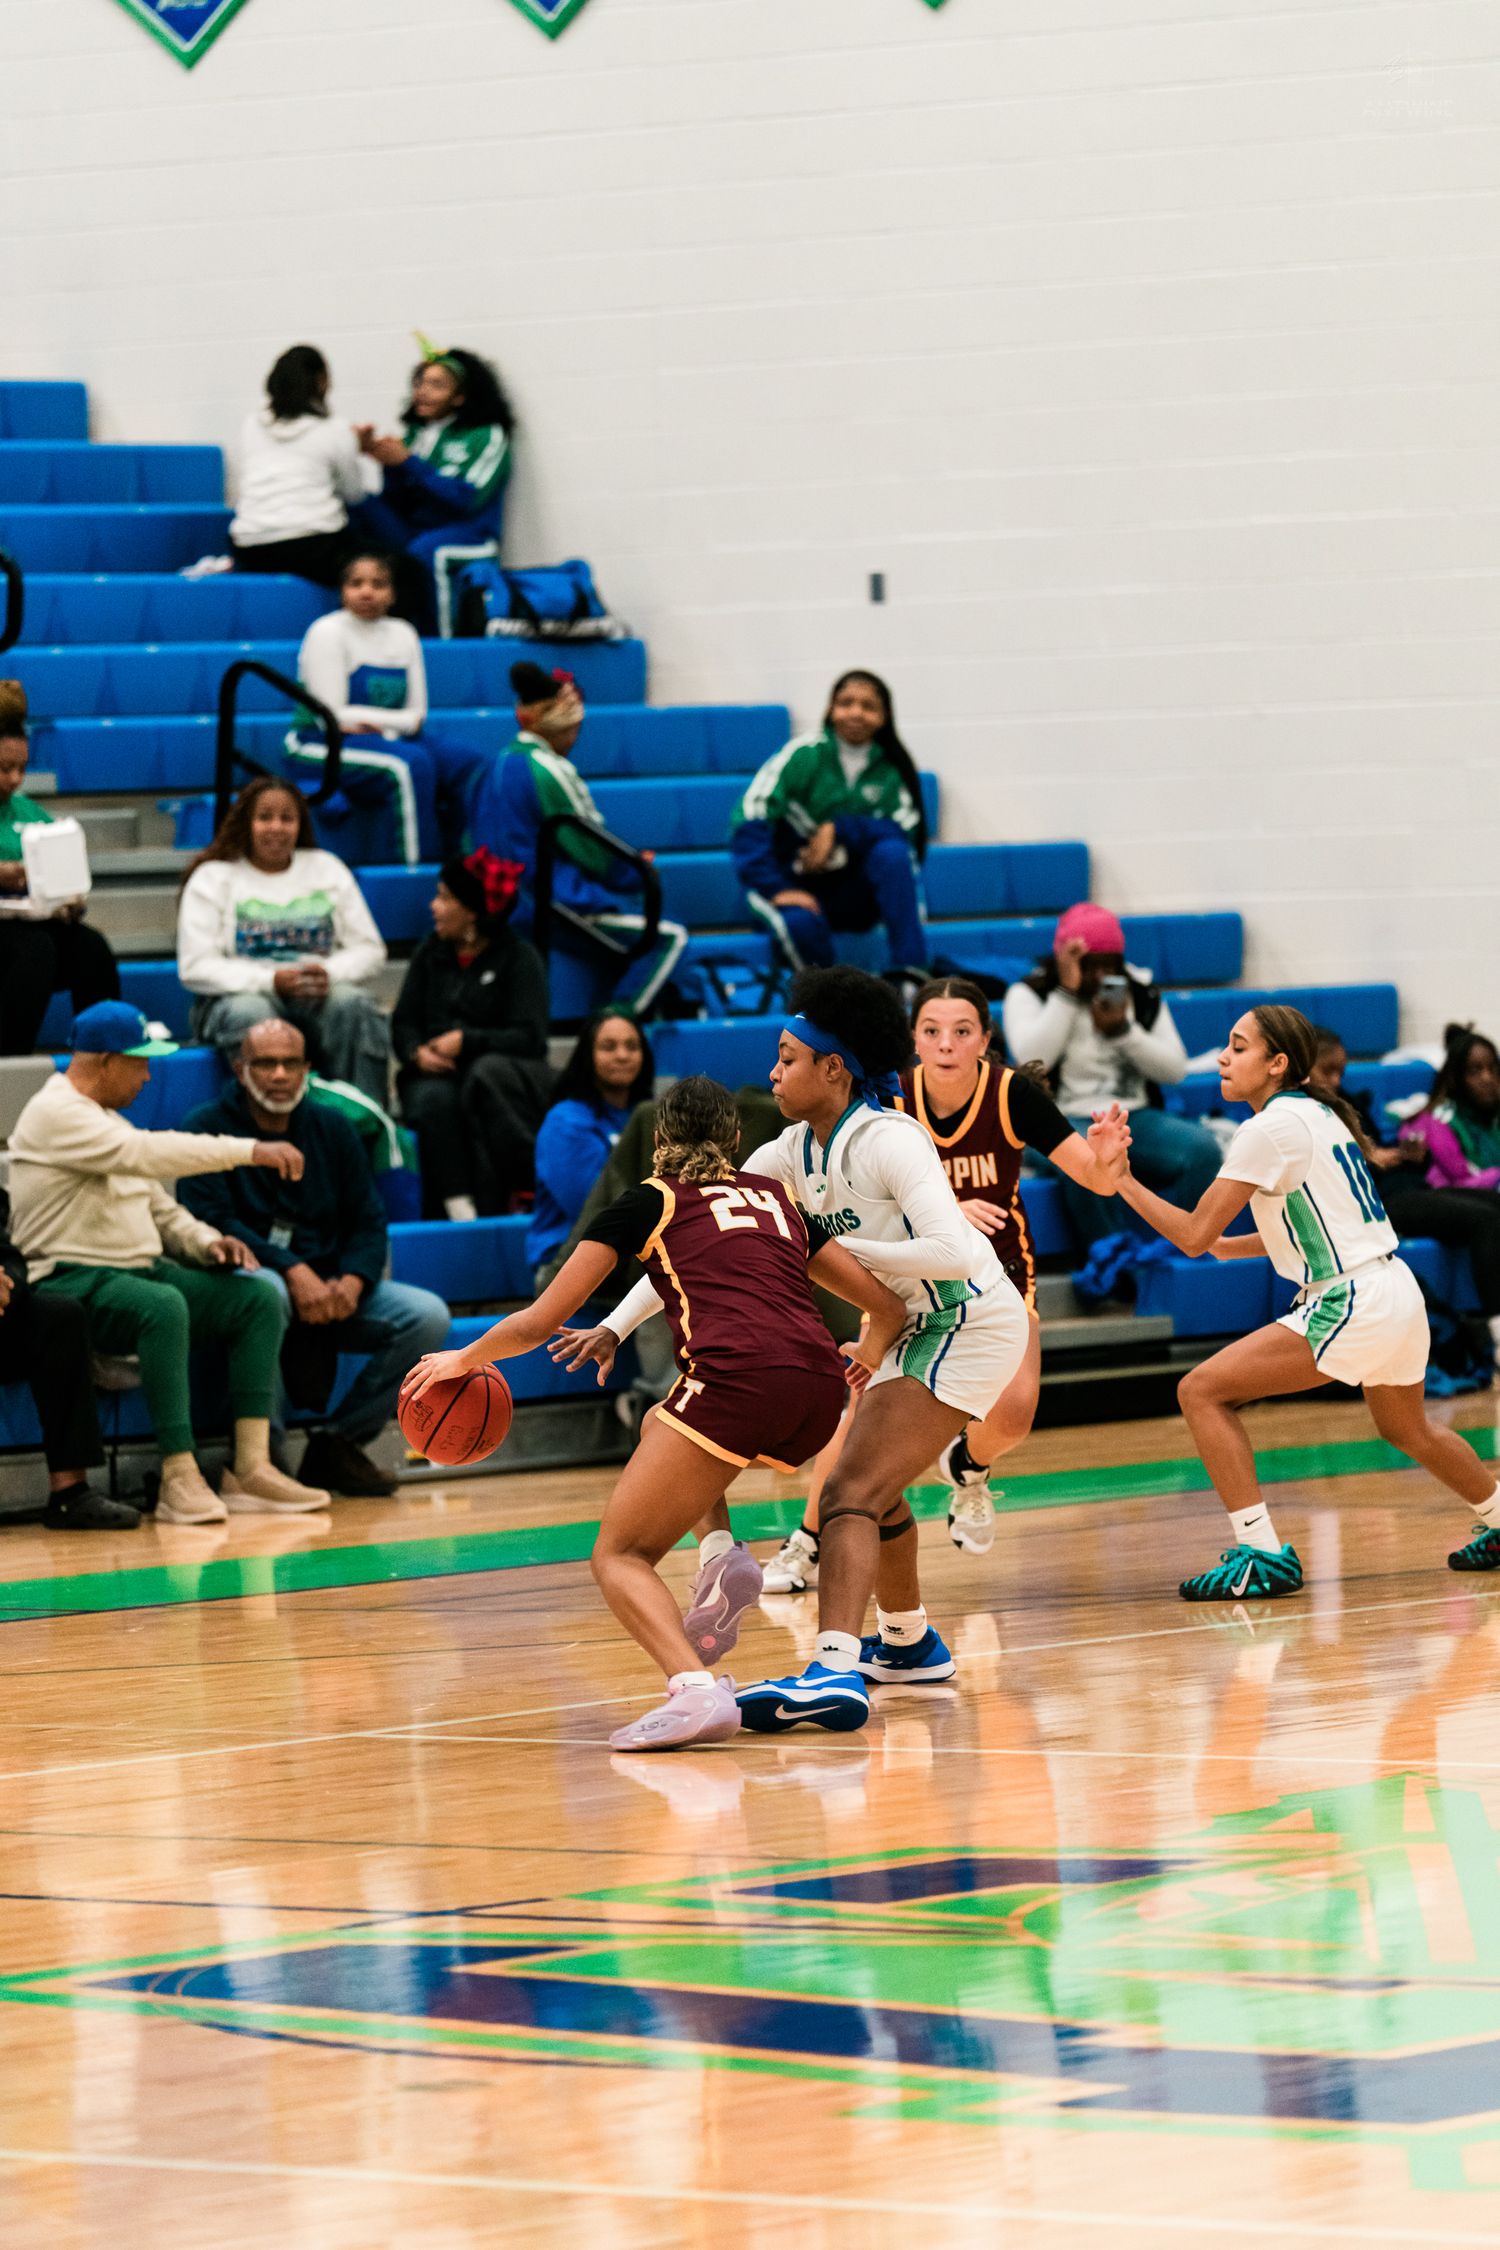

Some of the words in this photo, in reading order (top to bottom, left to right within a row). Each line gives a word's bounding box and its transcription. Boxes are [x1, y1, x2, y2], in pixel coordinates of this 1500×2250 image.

[1332, 1141, 1386, 1223] 10
[699, 1185, 793, 1241] 24
[673, 1375, 706, 1413] T
